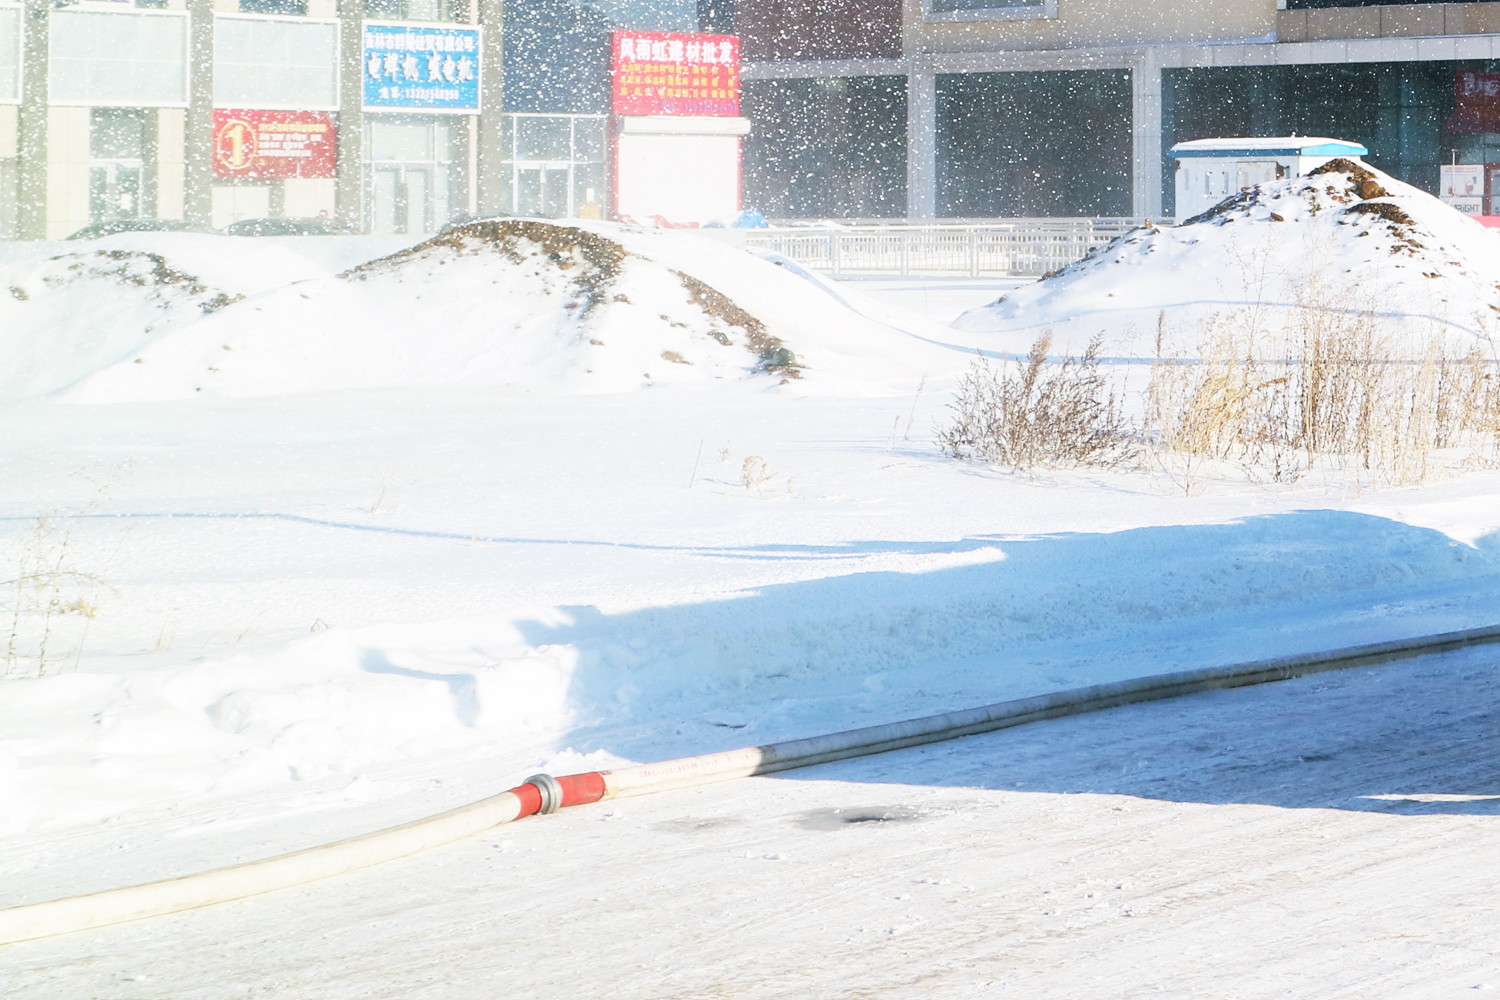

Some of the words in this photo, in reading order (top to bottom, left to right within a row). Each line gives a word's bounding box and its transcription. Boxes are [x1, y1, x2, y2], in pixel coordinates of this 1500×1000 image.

[620, 37, 734, 64] 风雨虹建材批发
